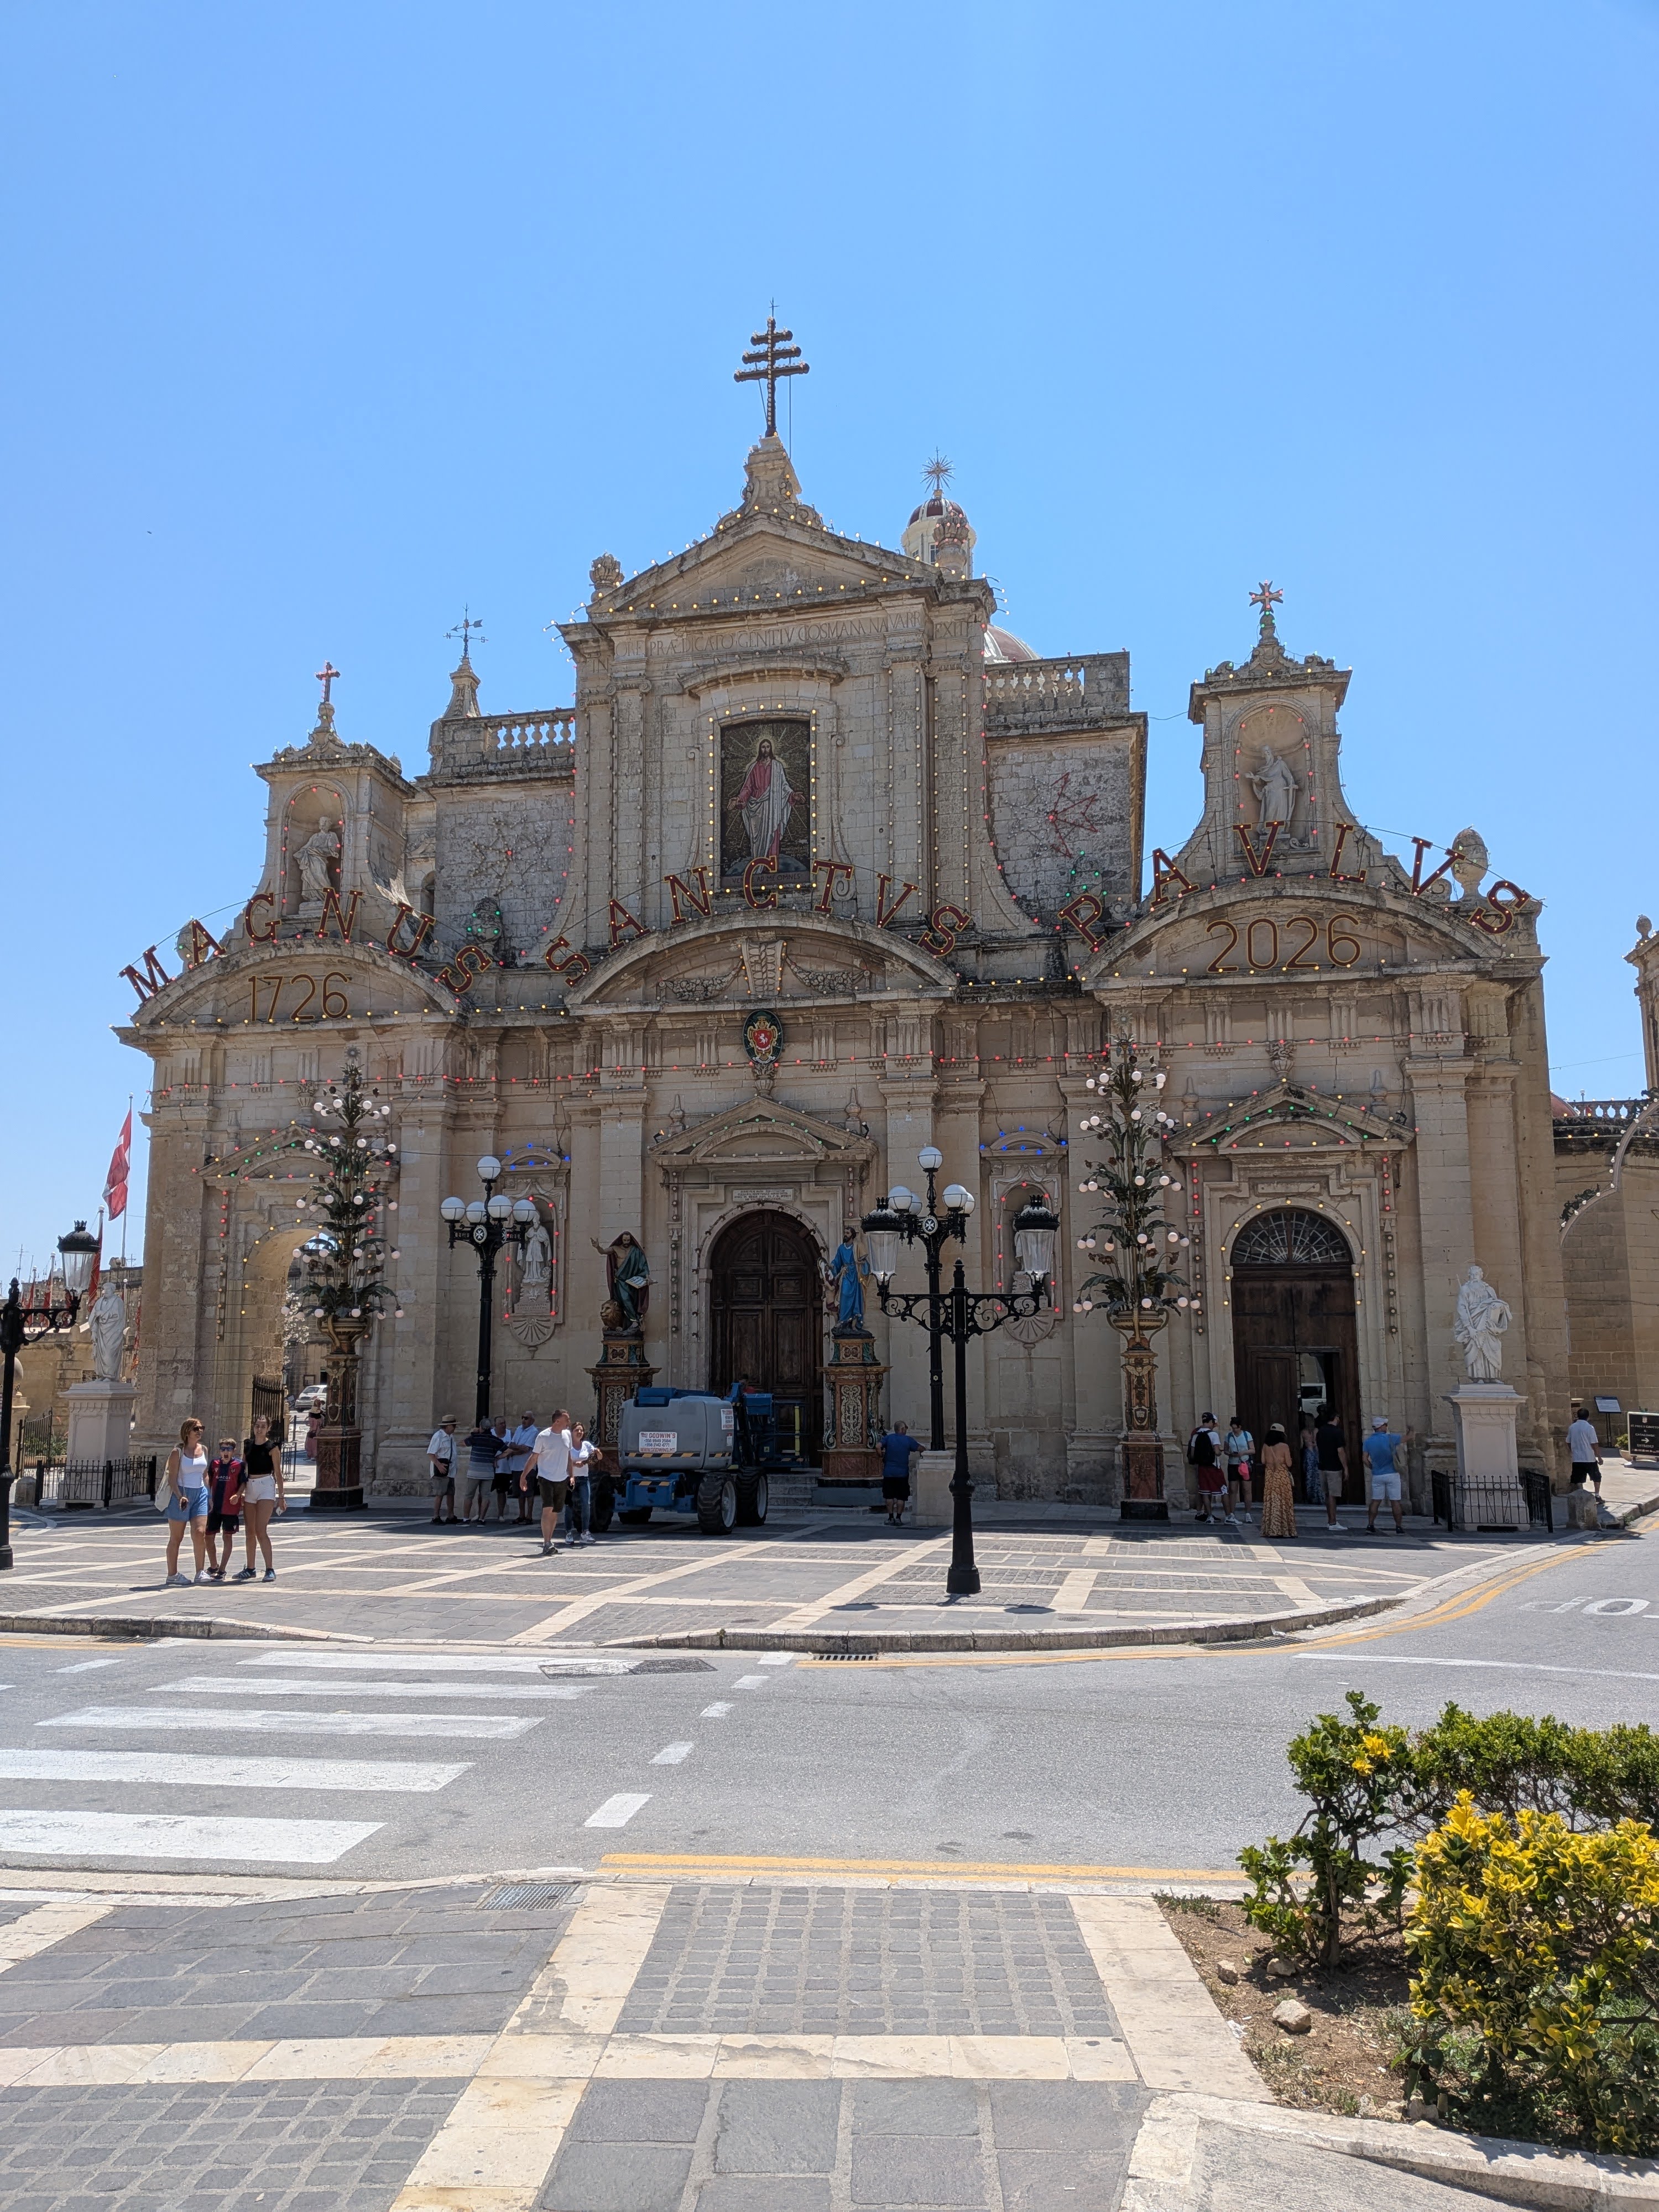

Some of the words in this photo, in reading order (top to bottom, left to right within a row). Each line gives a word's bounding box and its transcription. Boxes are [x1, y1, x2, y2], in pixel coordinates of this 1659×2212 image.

[615, 640, 645, 657] ORE
[544, 855, 972, 988] SANCTVS
[1058, 820, 1531, 952] PAVLVS
[118, 888, 492, 1003] MAGNUS
[1206, 914, 1362, 973] 2026
[248, 971, 349, 1022] 1726
